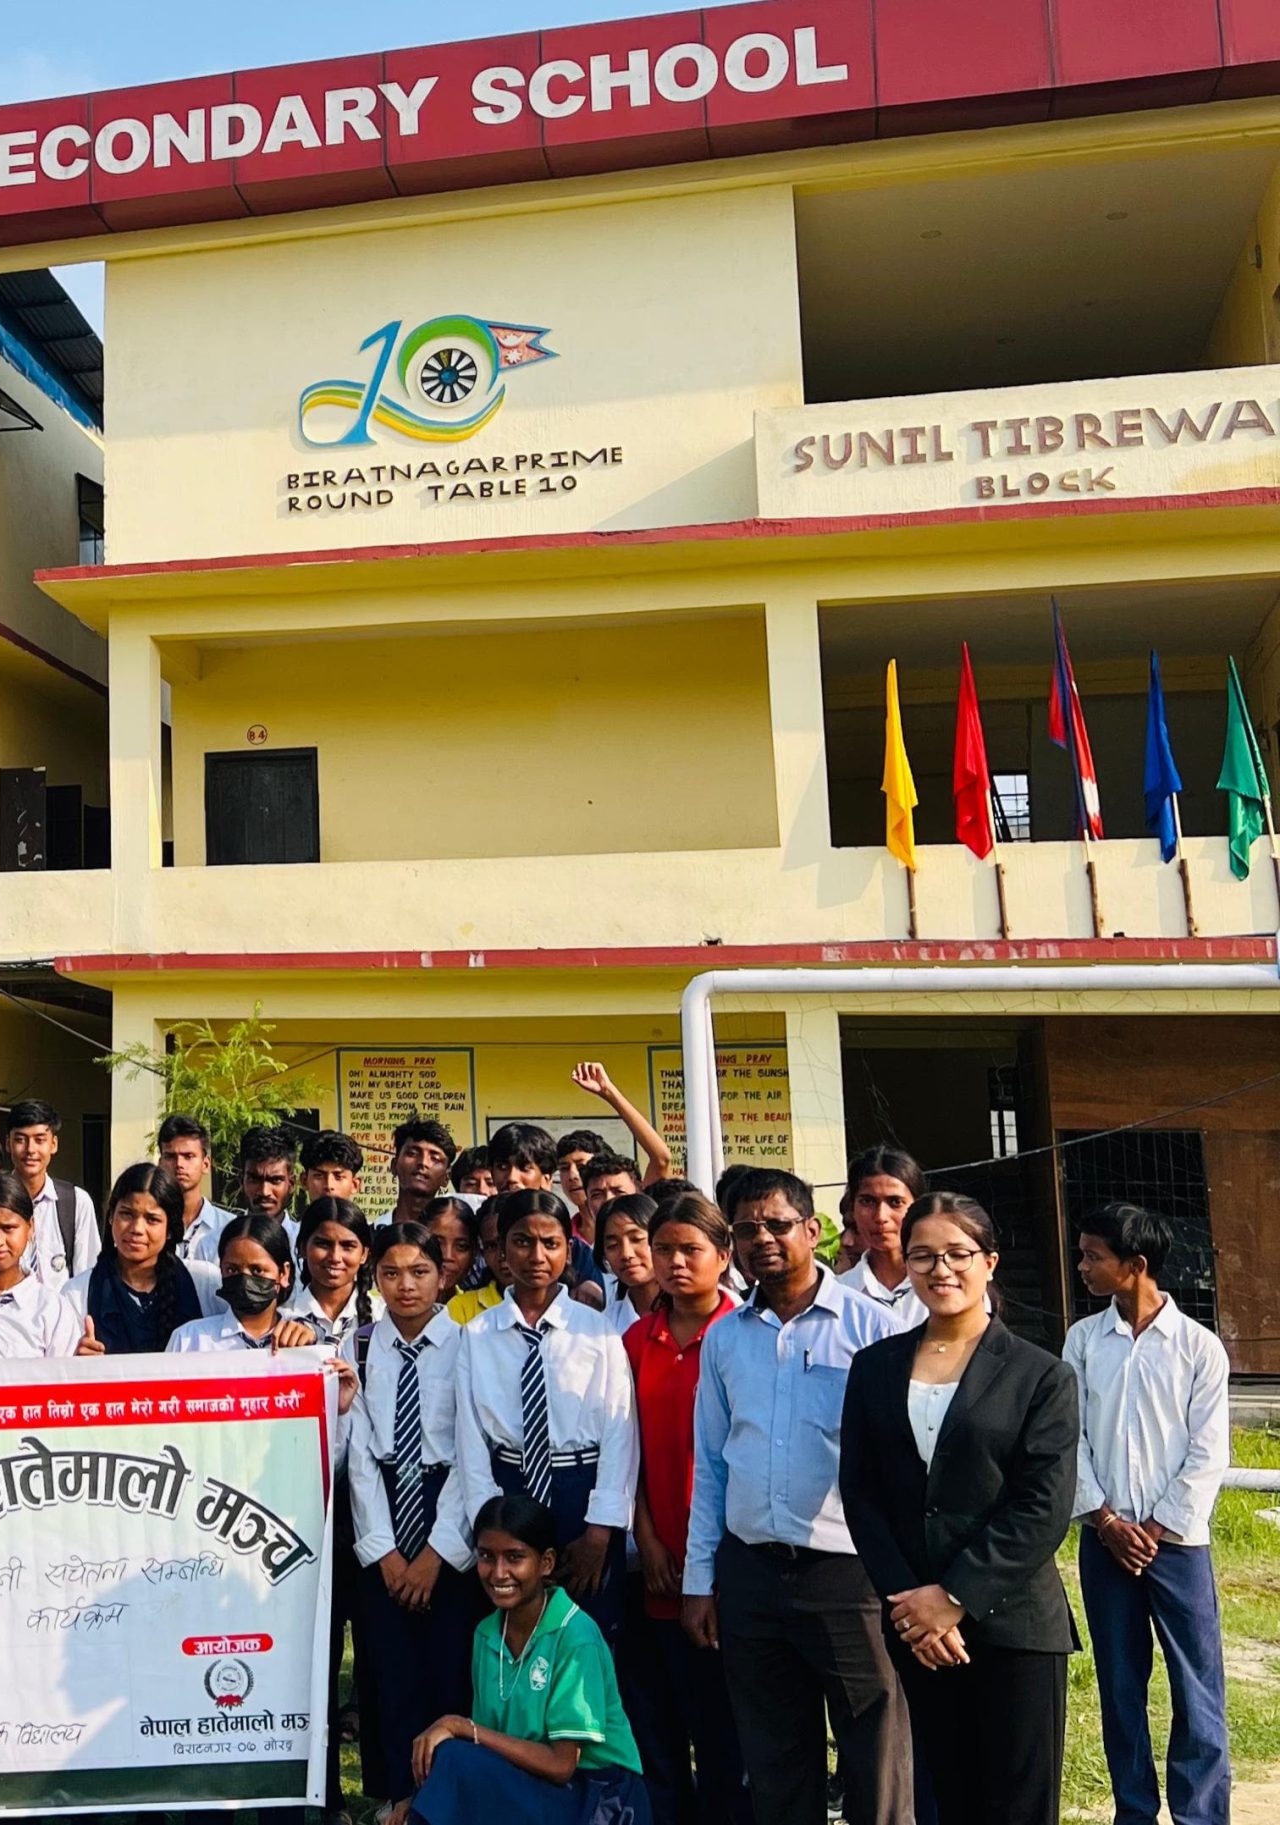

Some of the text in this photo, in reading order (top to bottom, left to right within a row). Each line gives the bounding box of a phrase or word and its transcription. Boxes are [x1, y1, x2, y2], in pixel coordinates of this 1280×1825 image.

[471, 26, 849, 125] SCHOOL
[794, 399, 1280, 472] SUNIL TIBREWA
[288, 446, 623, 490] BIRATNAGAR PRIME
[976, 466, 1117, 499] BLOCK
[288, 475, 577, 513] ROUND TABLE 10
[363, 1057, 436, 1066] MORNING PRAY
[746, 1053, 773, 1064] PRAY
[369, 1070, 414, 1078] ALMIGHTY
[733, 1069, 751, 1078] THE
[368, 1081, 381, 1089] MY
[385, 1081, 413, 1089] GREAT
[419, 1080, 441, 1089] LORD
[349, 1091, 466, 1100] MAKE US GOOD CHILDREN
[720, 1091, 738, 1099] FOR
[744, 1091, 761, 1099] THE
[767, 1091, 782, 1099] AIR
[375, 1102, 387, 1110] US
[392, 1102, 416, 1110] FROM
[422, 1102, 439, 1111] THE
[662, 1102, 685, 1111] BREA
[350, 1112, 369, 1120] GIVE
[373, 1112, 385, 1120] US
[662, 1113, 684, 1121] THAN
[721, 1113, 734, 1121] OR
[741, 1113, 758, 1121] THE
[350, 1122, 372, 1130] FROM
[374, 1132, 386, 1141] US
[735, 1135, 750, 1143] THE
[755, 1135, 773, 1143] LIFE
[778, 1134, 789, 1143] OF
[737, 1146, 755, 1155] THE
[761, 1146, 787, 1155] VOICE
[376, 1176, 388, 1184] US
[358, 1186, 397, 1195] LESS US
[21, 1403, 42, 1423] हात
[47, 1399, 75, 1418] तिम्रो
[80, 1402, 100, 1421] एक
[105, 1401, 125, 1419] हात
[131, 1397, 153, 1417] मेरो
[185, 1394, 235, 1415] समाजको
[239, 1395, 269, 1417] मुहार
[196, 1477, 316, 1583] मञ्च
[27, 1597, 130, 1632] कार्यक्रम
[194, 1636, 263, 1655] आयोजक
[139, 1716, 191, 1736] नेपाल
[197, 1709, 273, 1735] हातेमालो
